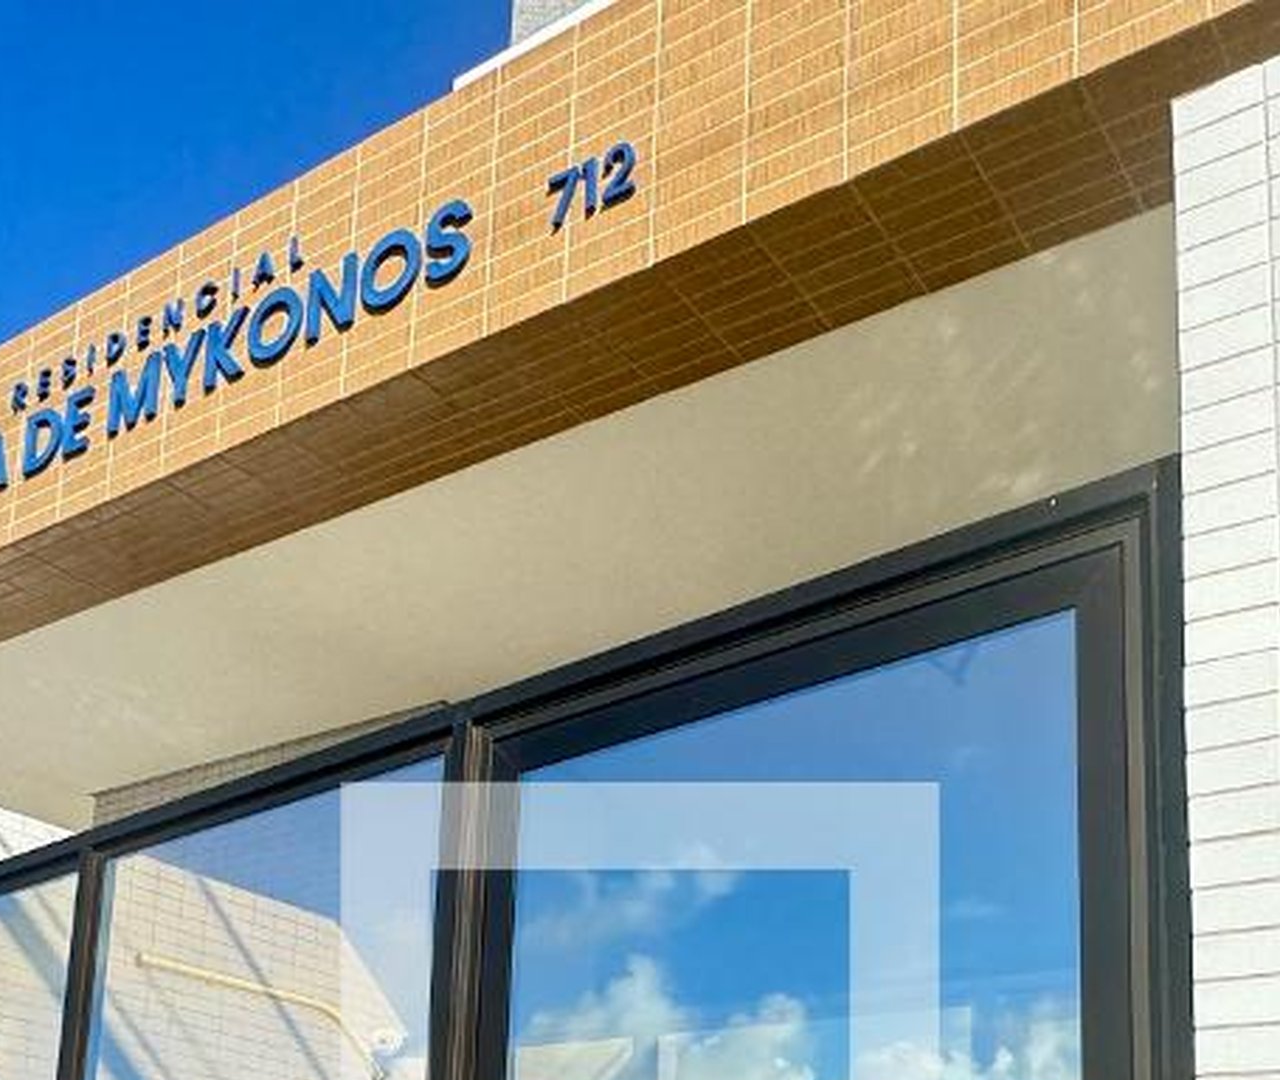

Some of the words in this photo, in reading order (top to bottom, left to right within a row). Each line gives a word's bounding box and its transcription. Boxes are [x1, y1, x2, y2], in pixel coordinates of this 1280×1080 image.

[548, 142, 637, 234] 712
[12, 232, 305, 415] RESIDENCIAL
[23, 384, 95, 480] DE
[107, 199, 473, 439] MYKONOS
